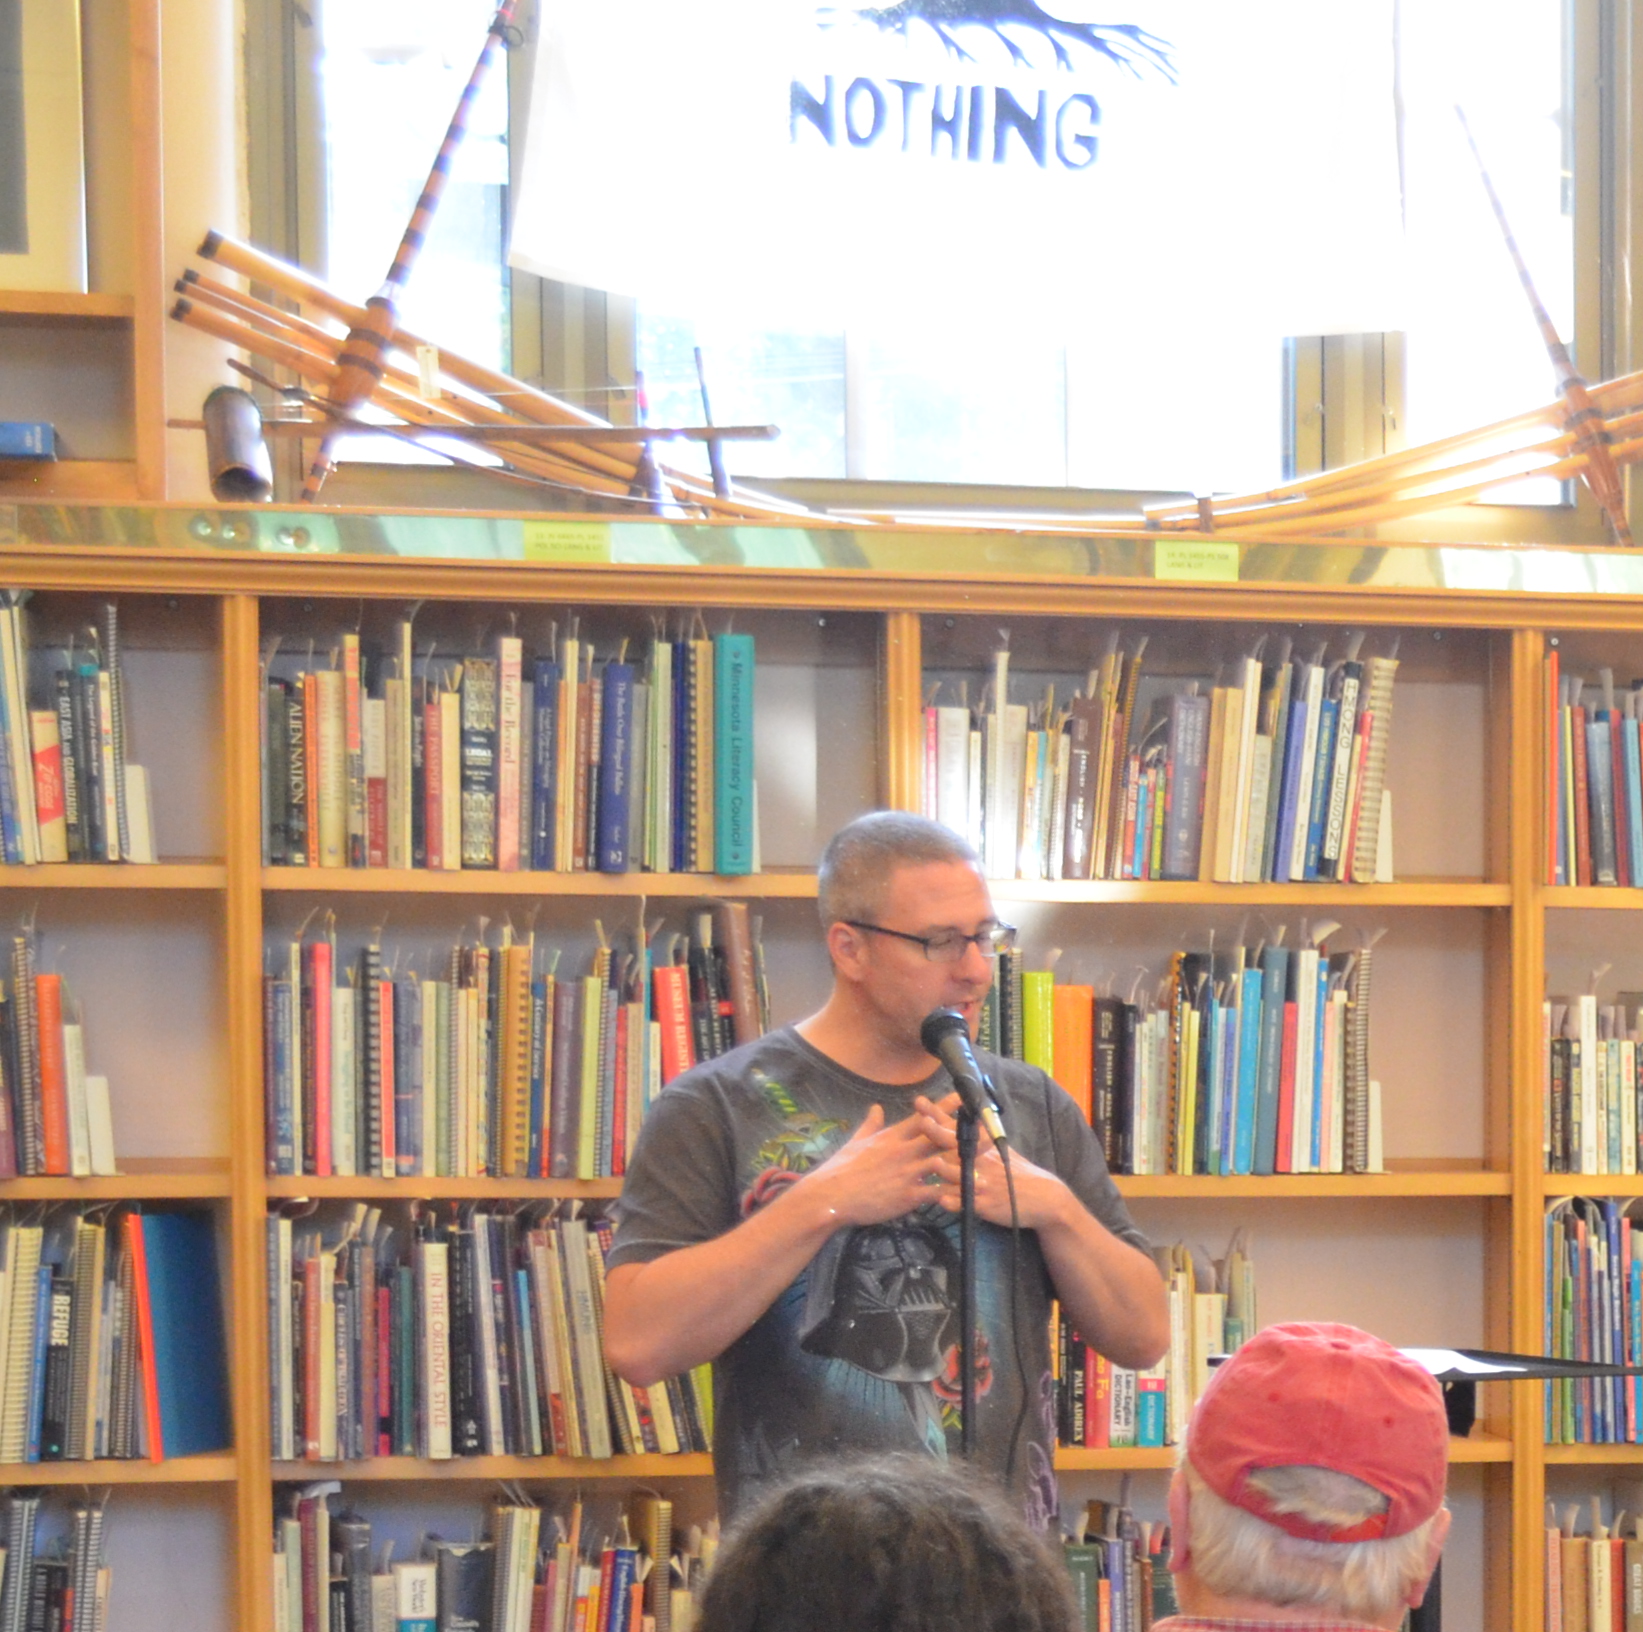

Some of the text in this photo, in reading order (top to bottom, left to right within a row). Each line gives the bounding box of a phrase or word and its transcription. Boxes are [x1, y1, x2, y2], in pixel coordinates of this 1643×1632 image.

[789, 75, 1101, 170] NOTHING
[59, 696, 70, 718] EAST
[505, 673, 518, 763] For the Record
[616, 682, 626, 695] The
[61, 720, 72, 740] ASIA
[289, 702, 304, 804] ALIEN NATION
[430, 711, 439, 795] THE PASSPORT
[729, 663, 743, 847] Minnesota Literacy Council
[64, 757, 77, 824] GLOBALIZATION
[1326, 680, 1357, 859] HMONG LESSONS
[669, 972, 685, 1022] MUSEUM
[50, 1295, 71, 1346] REFUGE
[431, 1273, 447, 1428] IN THE ORIENTAL STYLE
[1074, 1370, 1083, 1442] PAUL ADIREX
[1123, 1373, 1133, 1427] Lao-English
[1147, 1395, 1156, 1440] DICTIONARY
[1549, 1537, 1558, 1580] HEALING
[1633, 1563, 1642, 1587] GREAT
